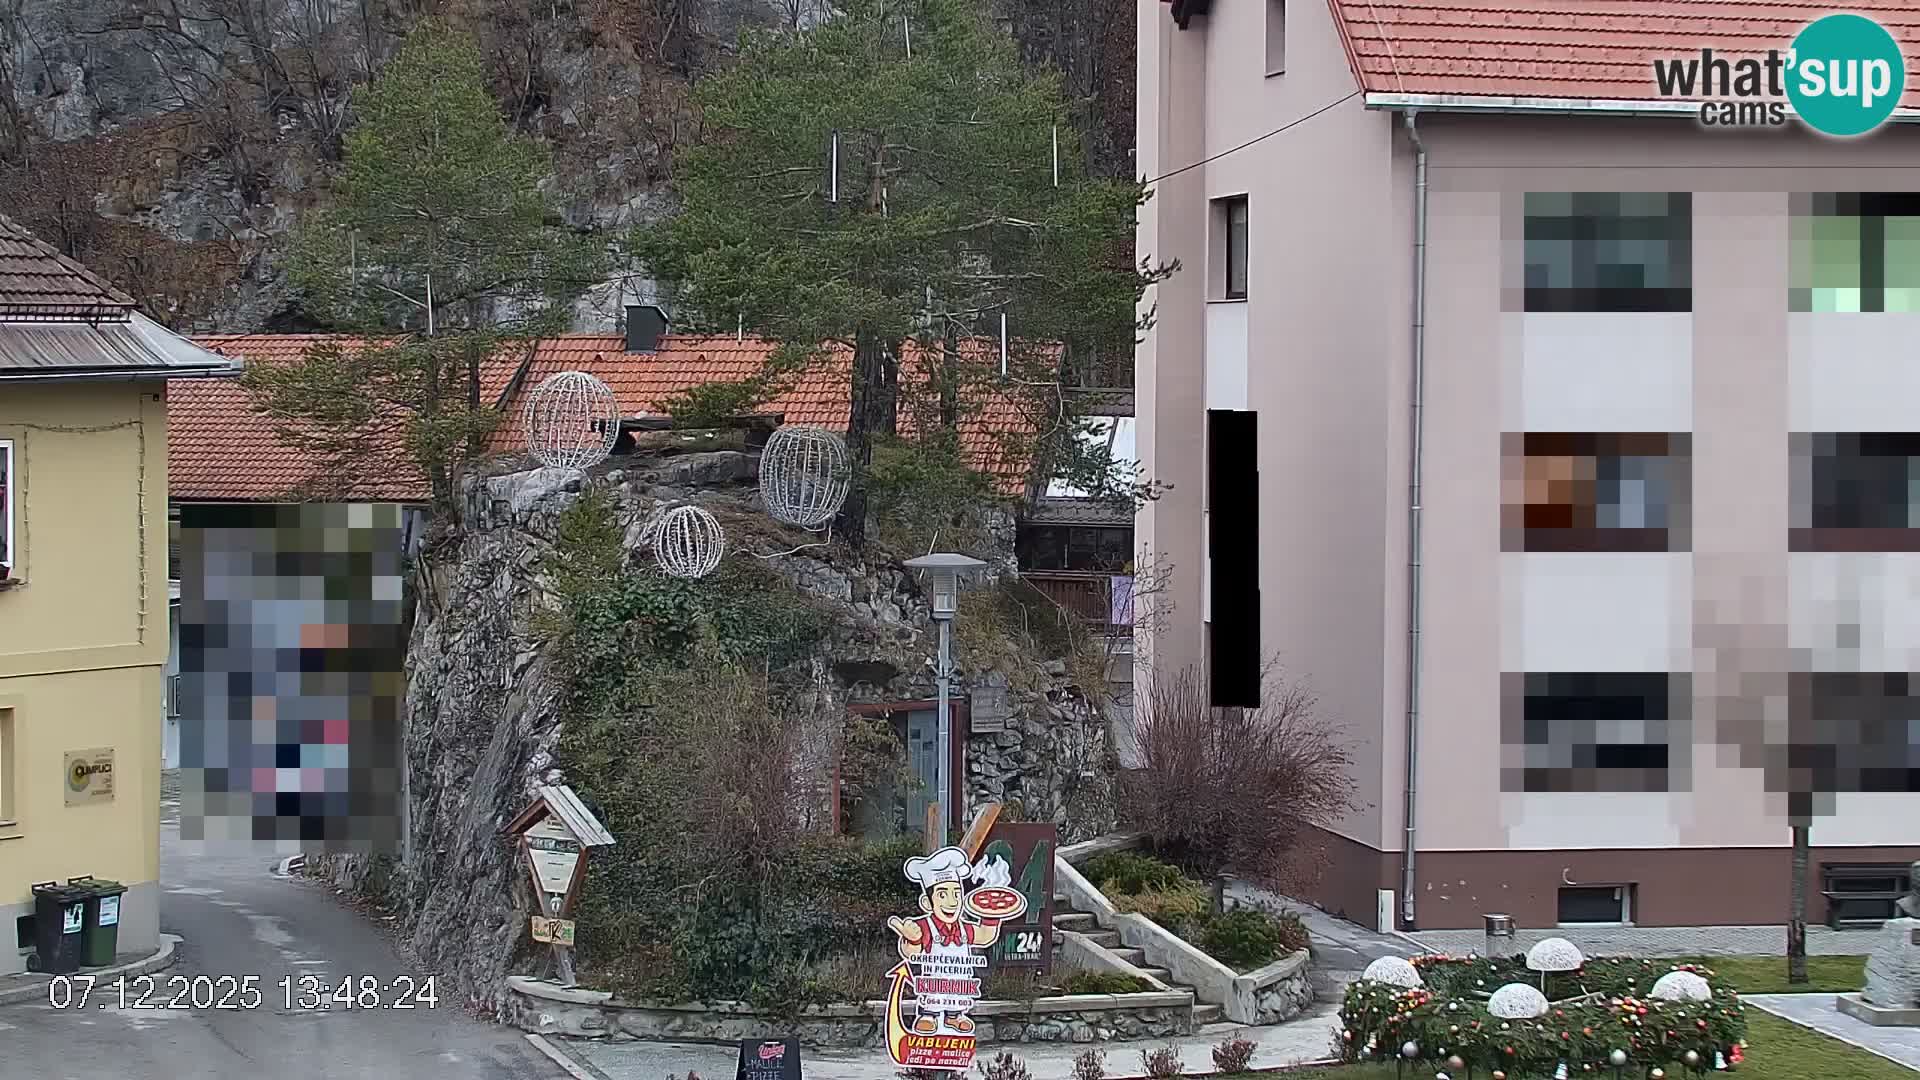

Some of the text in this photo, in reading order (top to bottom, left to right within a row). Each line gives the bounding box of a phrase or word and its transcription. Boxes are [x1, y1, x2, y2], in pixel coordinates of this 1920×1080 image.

[911, 954, 987, 966] OKREPČEVALNICA
[924, 965, 972, 975] IN PICERIJA
[917, 978, 978, 995] KURNIK
[908, 1036, 976, 1049] VABLJENI
[924, 1057, 936, 1066] po
